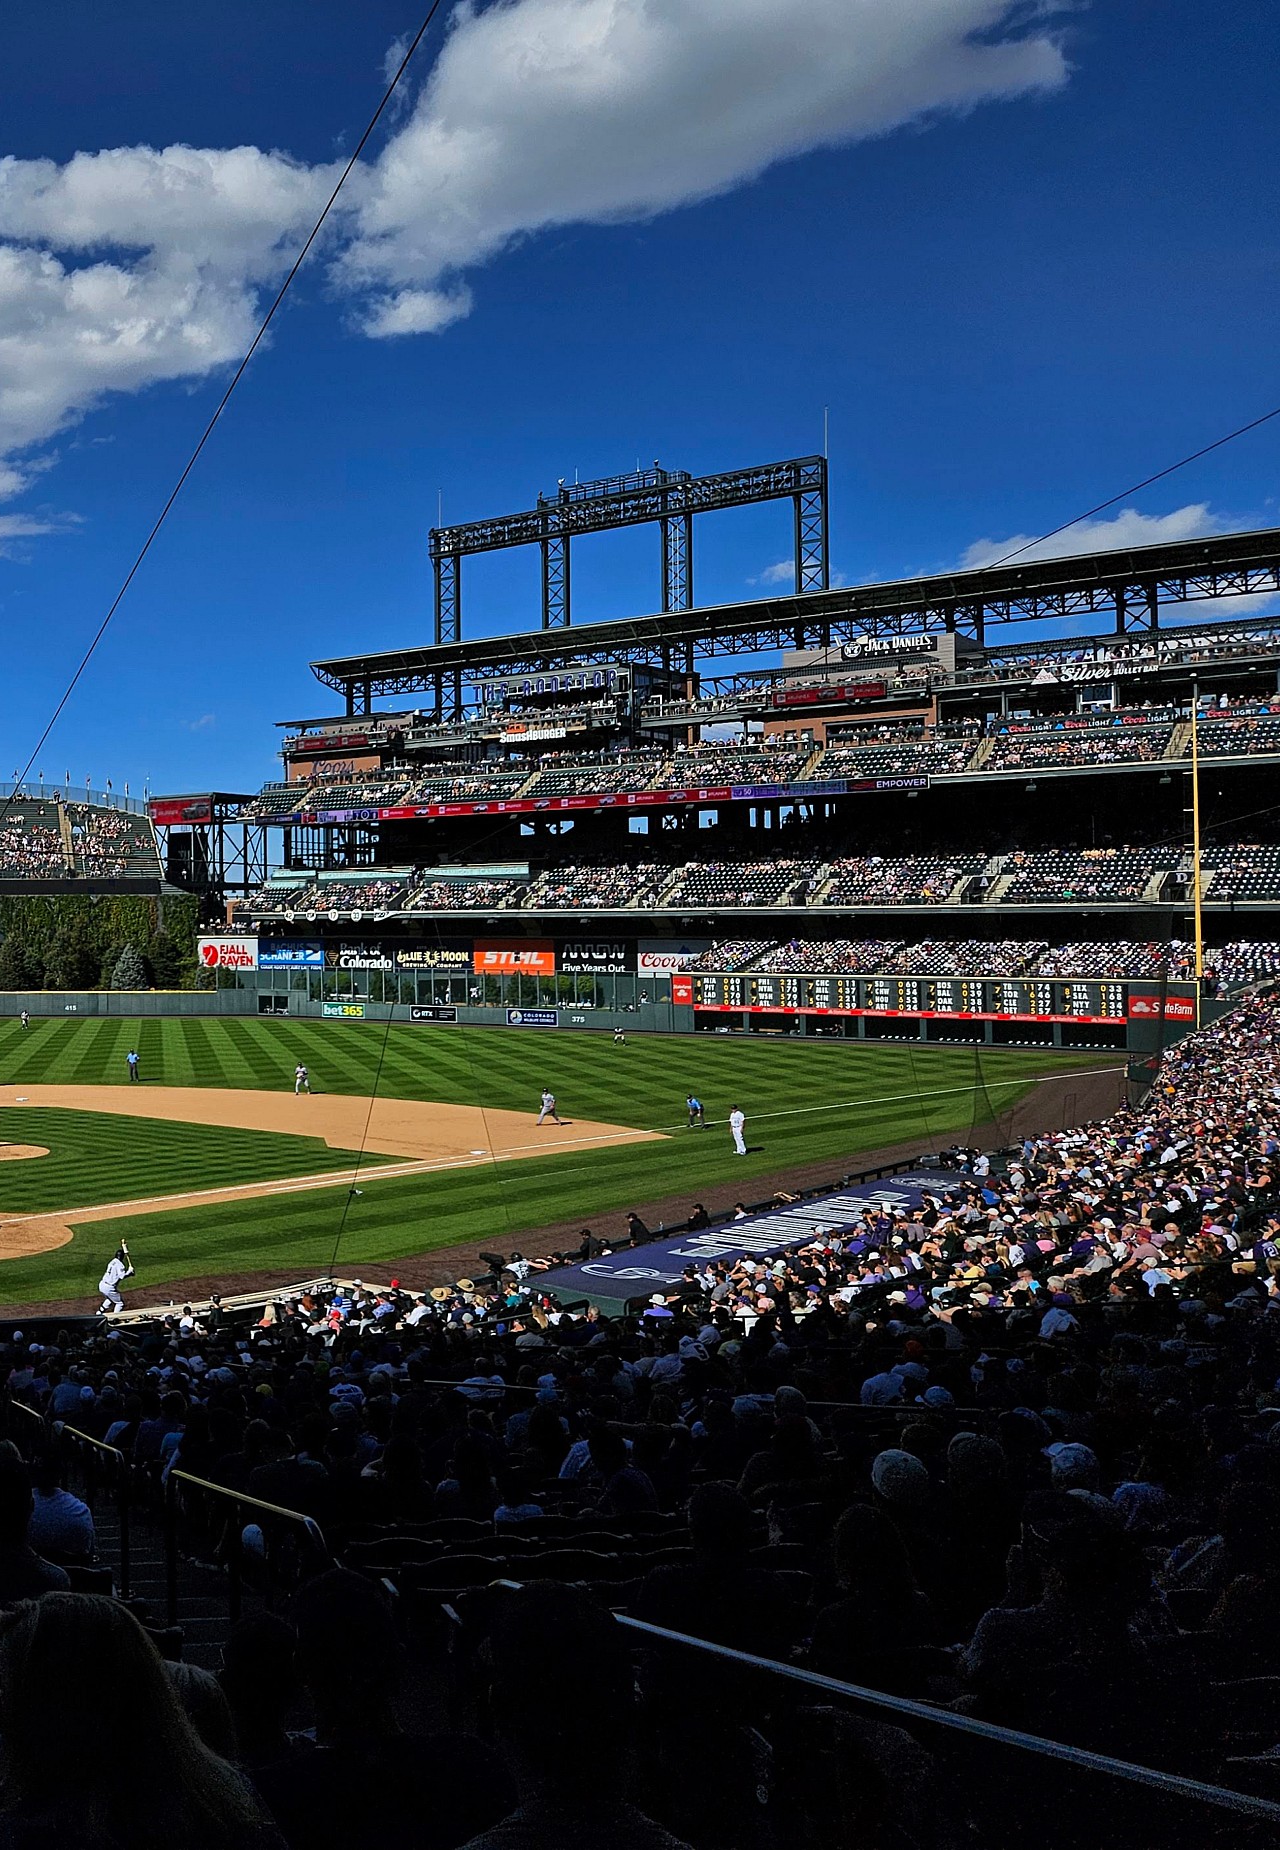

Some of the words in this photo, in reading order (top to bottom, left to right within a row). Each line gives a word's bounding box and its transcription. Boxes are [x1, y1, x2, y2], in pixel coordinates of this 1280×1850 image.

[1060, 665, 1112, 682] Silver
[1114, 666, 1142, 676] BULLET
[1143, 665, 1159, 673] BAR
[473, 681, 509, 702] THE
[522, 668, 617, 698] ROOFTOP
[1207, 709, 1231, 718] Coors
[1232, 708, 1255, 717] LIGHT
[1088, 719, 1110, 727] LIGHT
[1123, 715, 1146, 724] Coors
[1147, 715, 1169, 723] LIGHT
[1008, 724, 1031, 733] Coors
[876, 778, 926, 788] EMPOWER
[270, 943, 305, 951] BACHUS
[340, 943, 357, 955] Bank
[397, 949, 422, 962] BLUE
[441, 951, 470, 962] MOON
[641, 952, 687, 968] Coors
[339, 955, 392, 969] Colorado
[562, 963, 581, 972] Five
[581, 963, 606, 972] Years
[608, 964, 625, 972] Out
[323, 1004, 363, 1016] bet365
[1152, 1002, 1193, 1016] SteFarm
